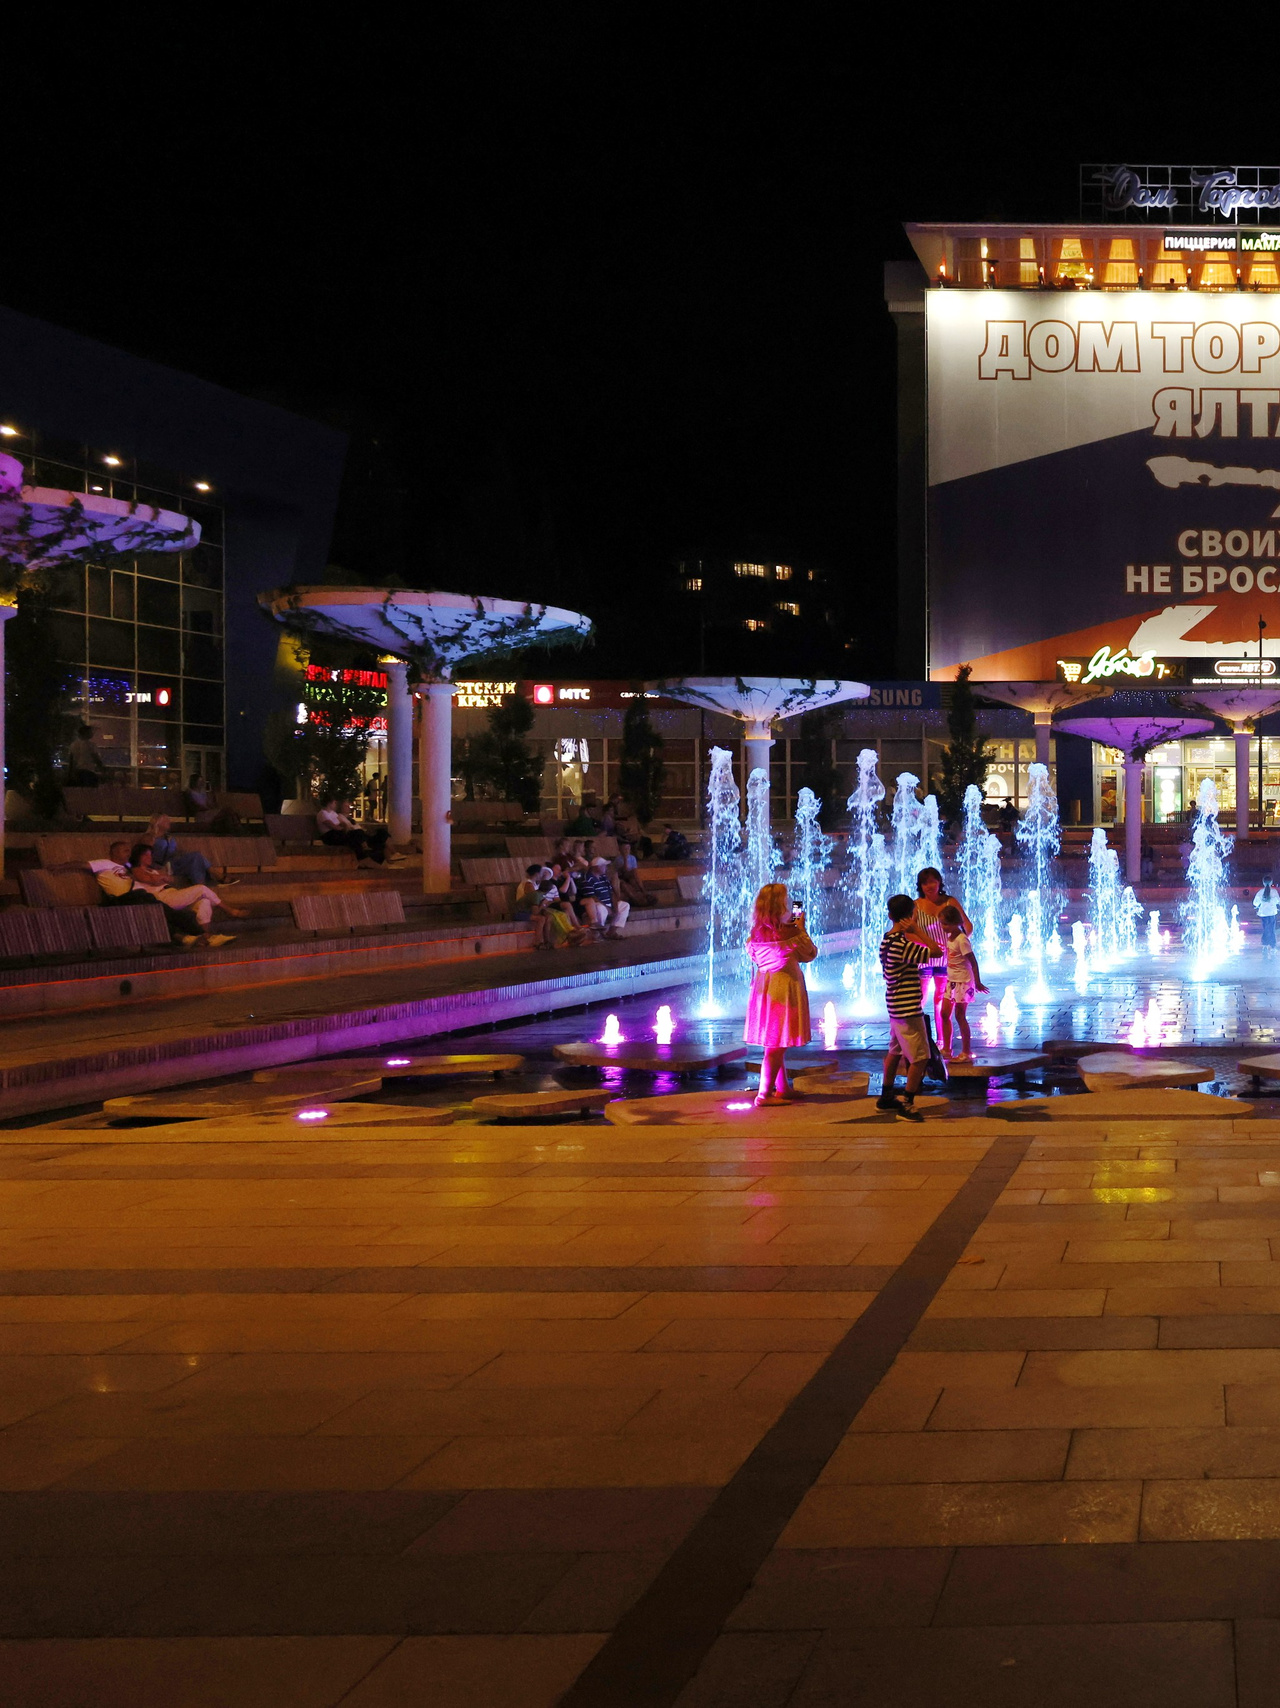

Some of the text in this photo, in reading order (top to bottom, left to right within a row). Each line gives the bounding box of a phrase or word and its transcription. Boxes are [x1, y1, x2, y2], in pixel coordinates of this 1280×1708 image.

[1165, 236, 1236, 251] ПИЦЦЕРИЯ
[977, 320, 1141, 380] ДОМ
[1126, 565, 1172, 593] НЕ
[453, 681, 516, 694] ЕТСКИЙ
[457, 695, 503, 706] КРЫМ
